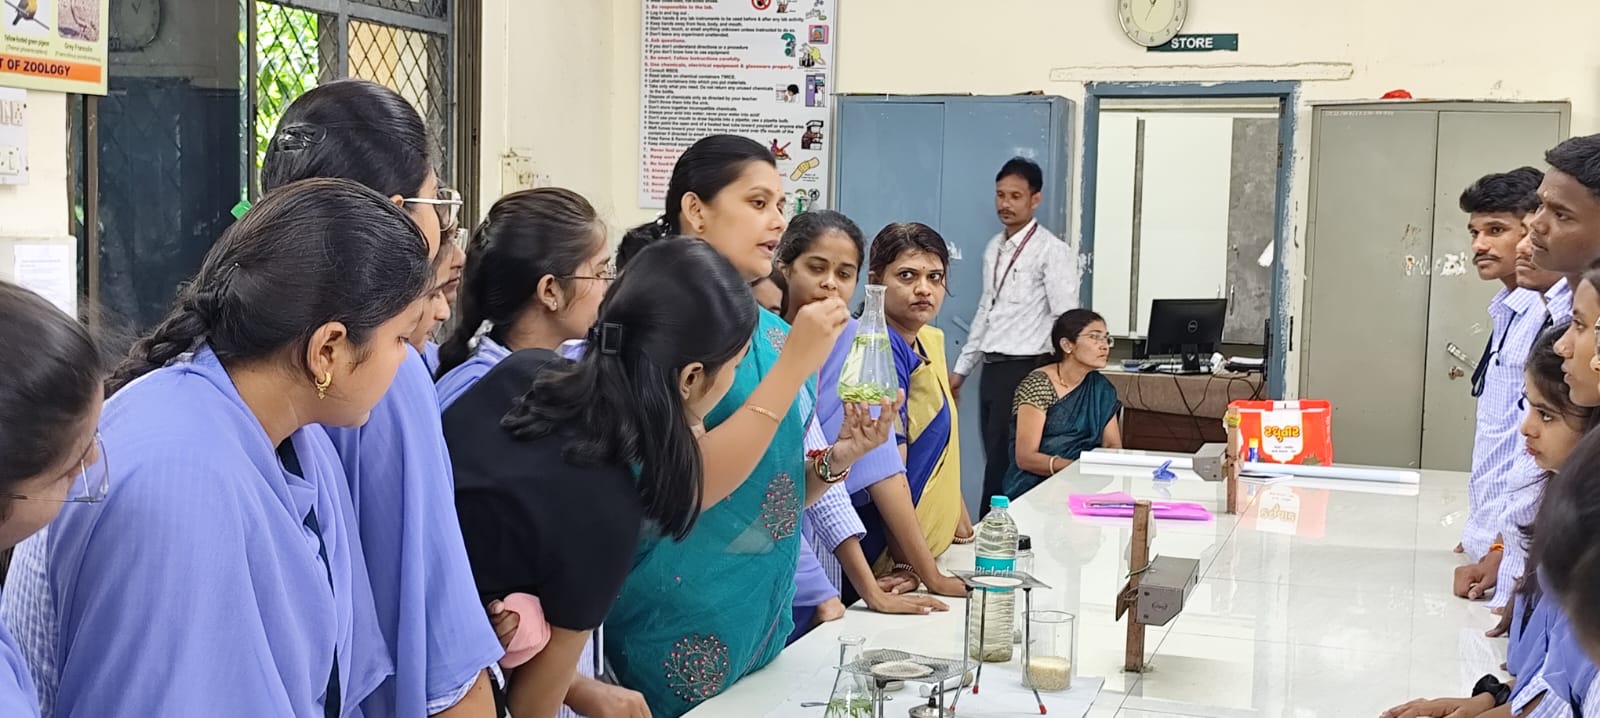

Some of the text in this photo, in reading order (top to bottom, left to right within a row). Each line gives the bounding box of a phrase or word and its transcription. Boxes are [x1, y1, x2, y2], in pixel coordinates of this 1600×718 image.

[1171, 38, 1213, 48] STORE
[8, 60, 20, 70] OF
[23, 61, 71, 76] ZOOLOGY
